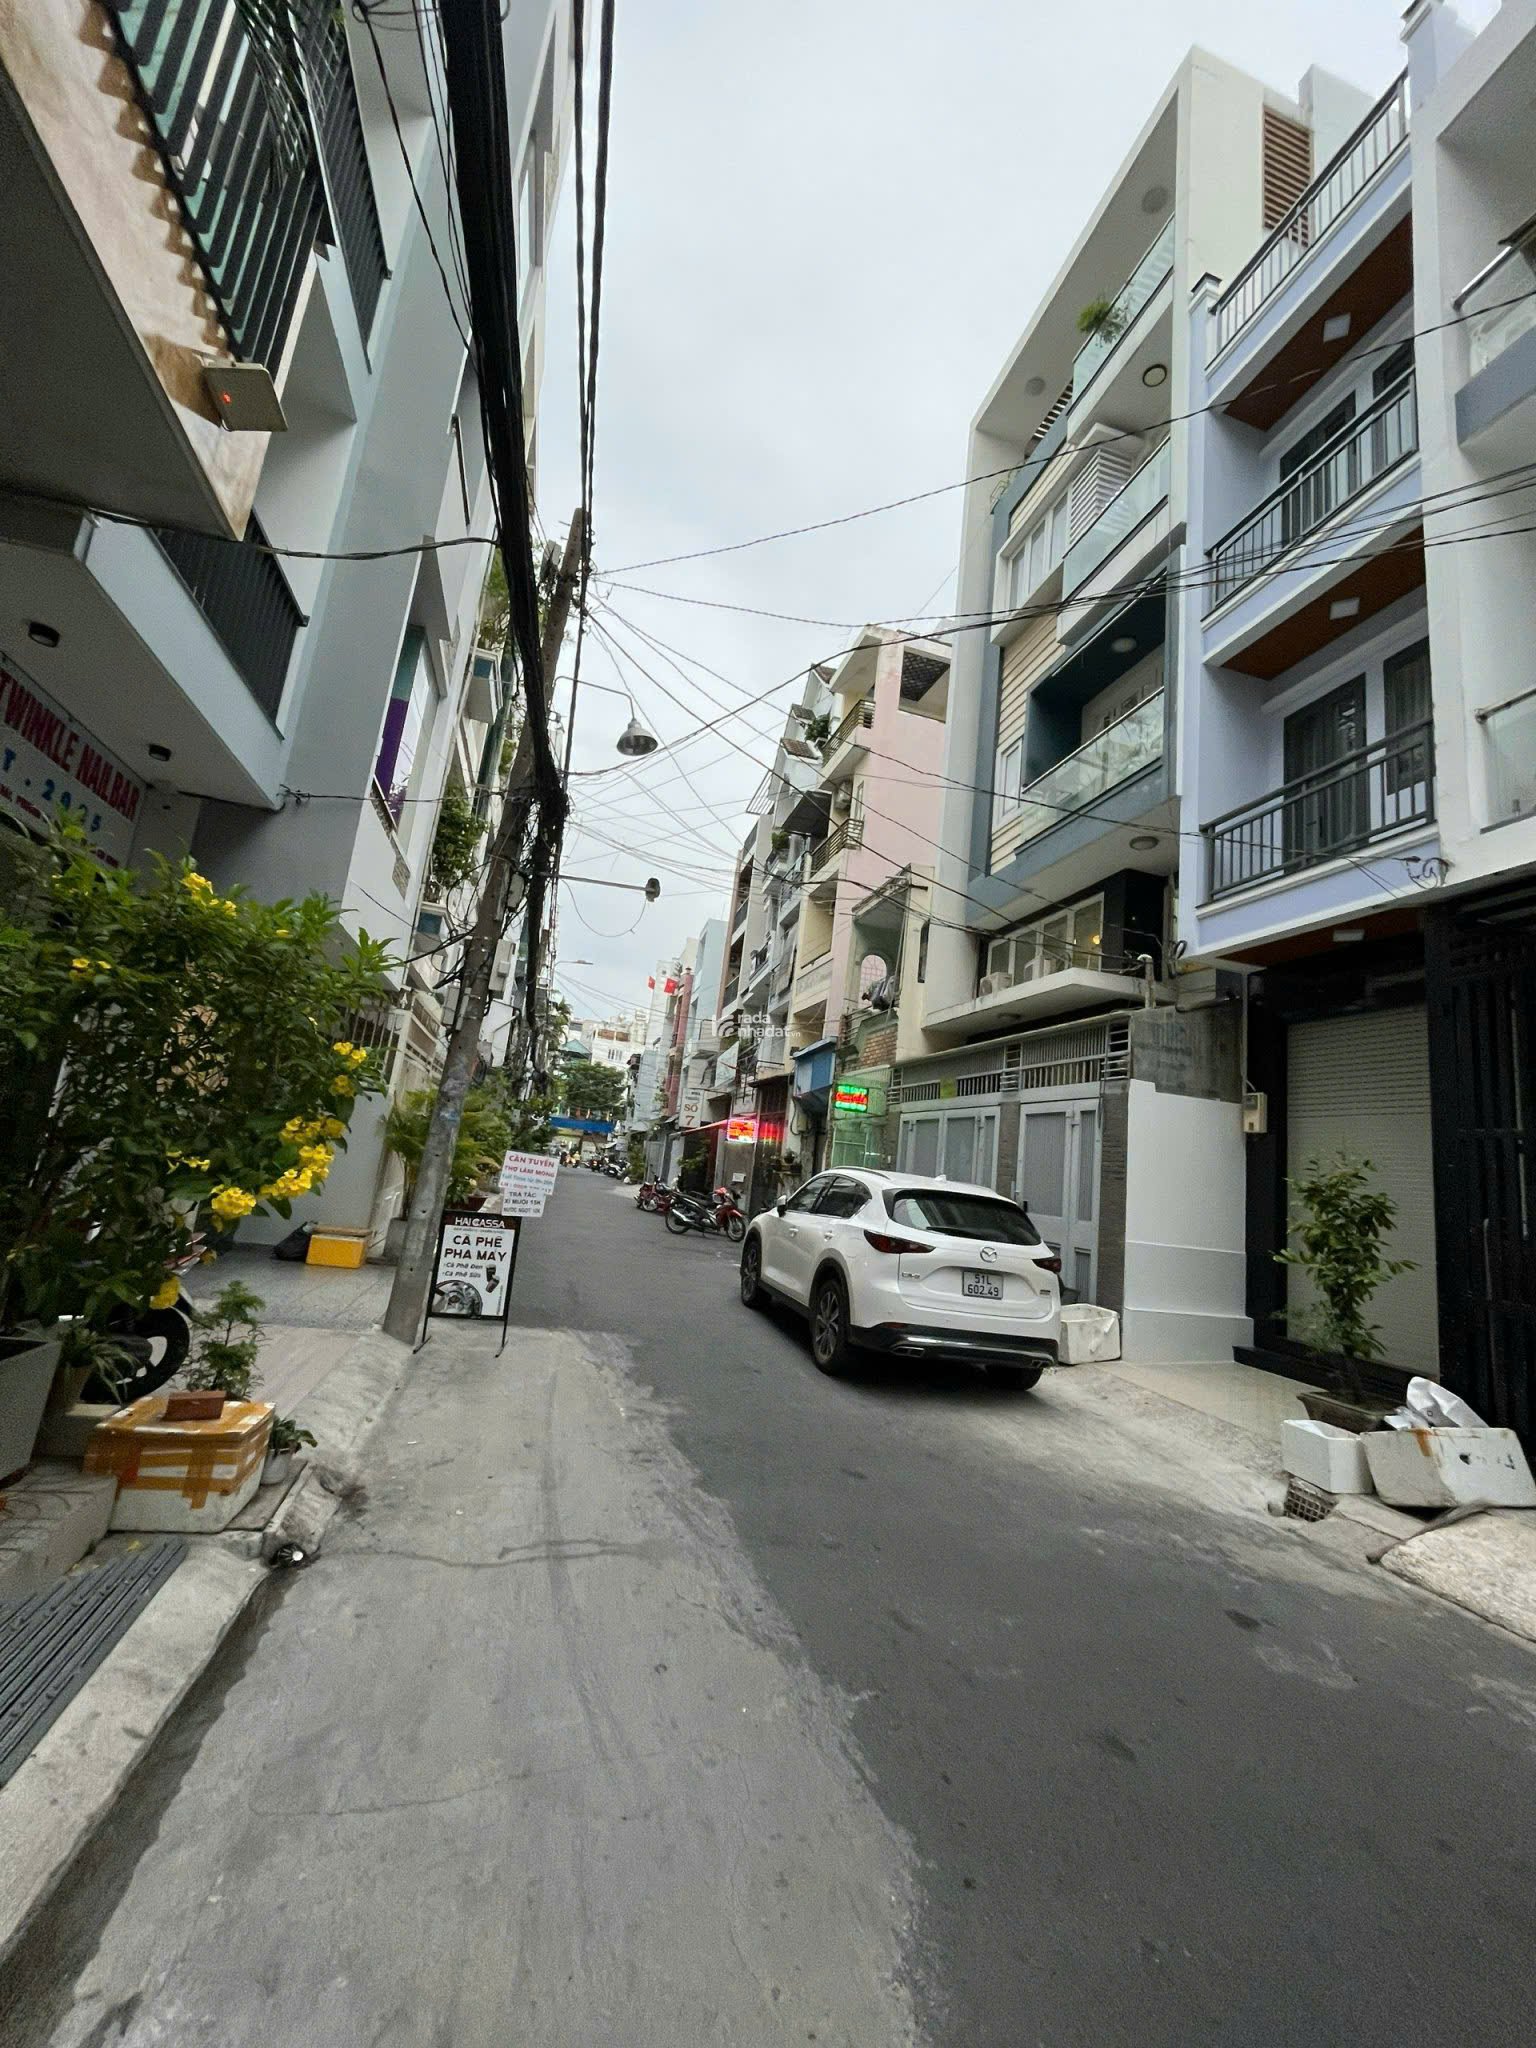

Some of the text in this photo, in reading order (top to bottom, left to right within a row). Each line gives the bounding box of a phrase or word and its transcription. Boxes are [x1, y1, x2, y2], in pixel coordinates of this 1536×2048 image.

[685, 1116, 695, 1125] 7
[476, 1235, 503, 1248] PHÊ
[444, 1248, 472, 1259] PHA
[975, 1274, 992, 1285] 51L
[967, 1284, 999, 1297] 602.49
